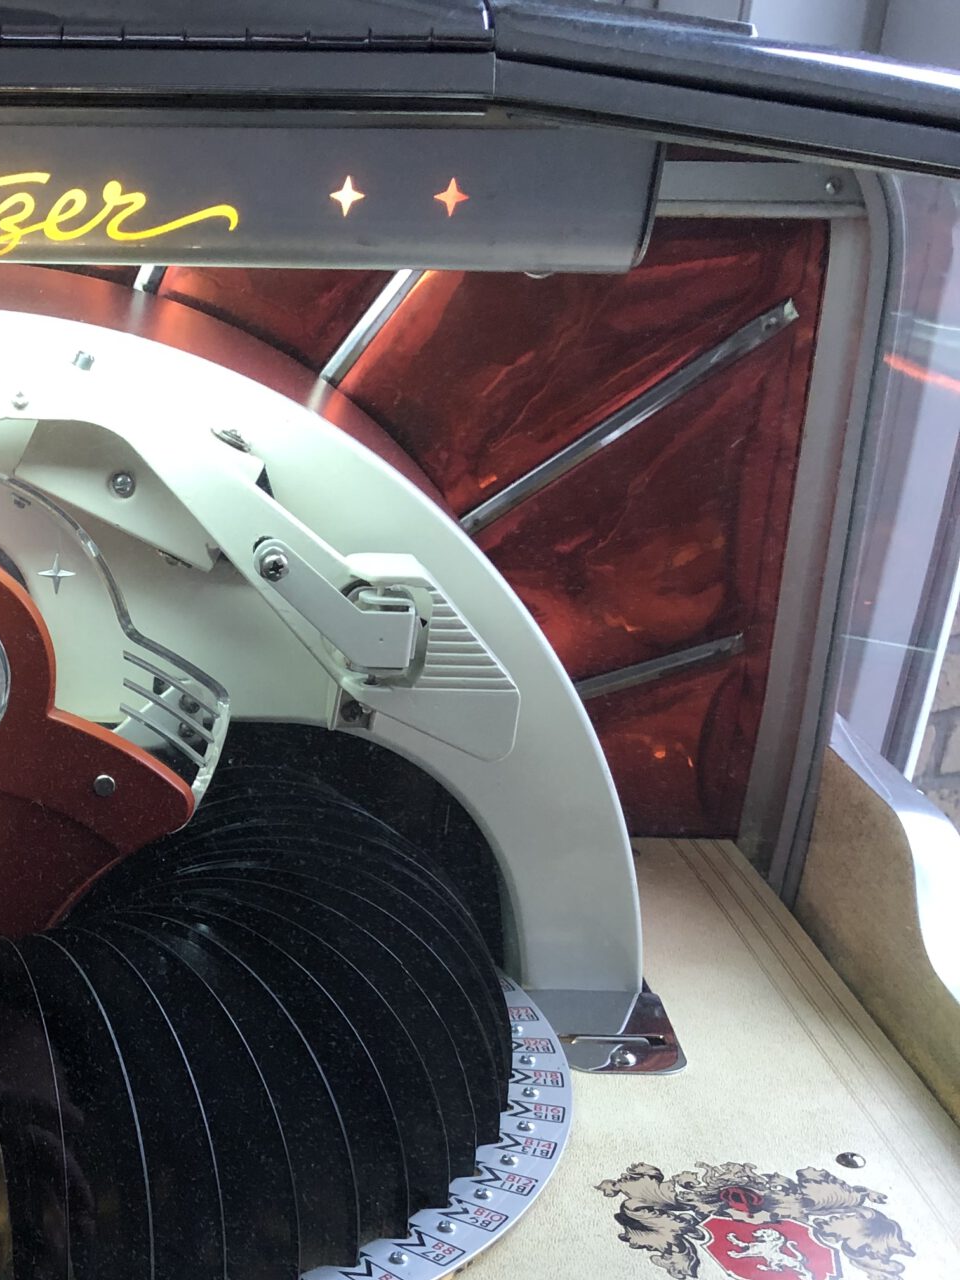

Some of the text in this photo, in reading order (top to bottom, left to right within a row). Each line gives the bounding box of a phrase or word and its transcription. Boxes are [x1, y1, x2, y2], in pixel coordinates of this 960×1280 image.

[533, 1103, 561, 1114] B16
[524, 1136, 553, 1150] B14
[505, 1173, 533, 1187] B12
[473, 1207, 503, 1223] B10
[431, 1240, 456, 1256] B8
